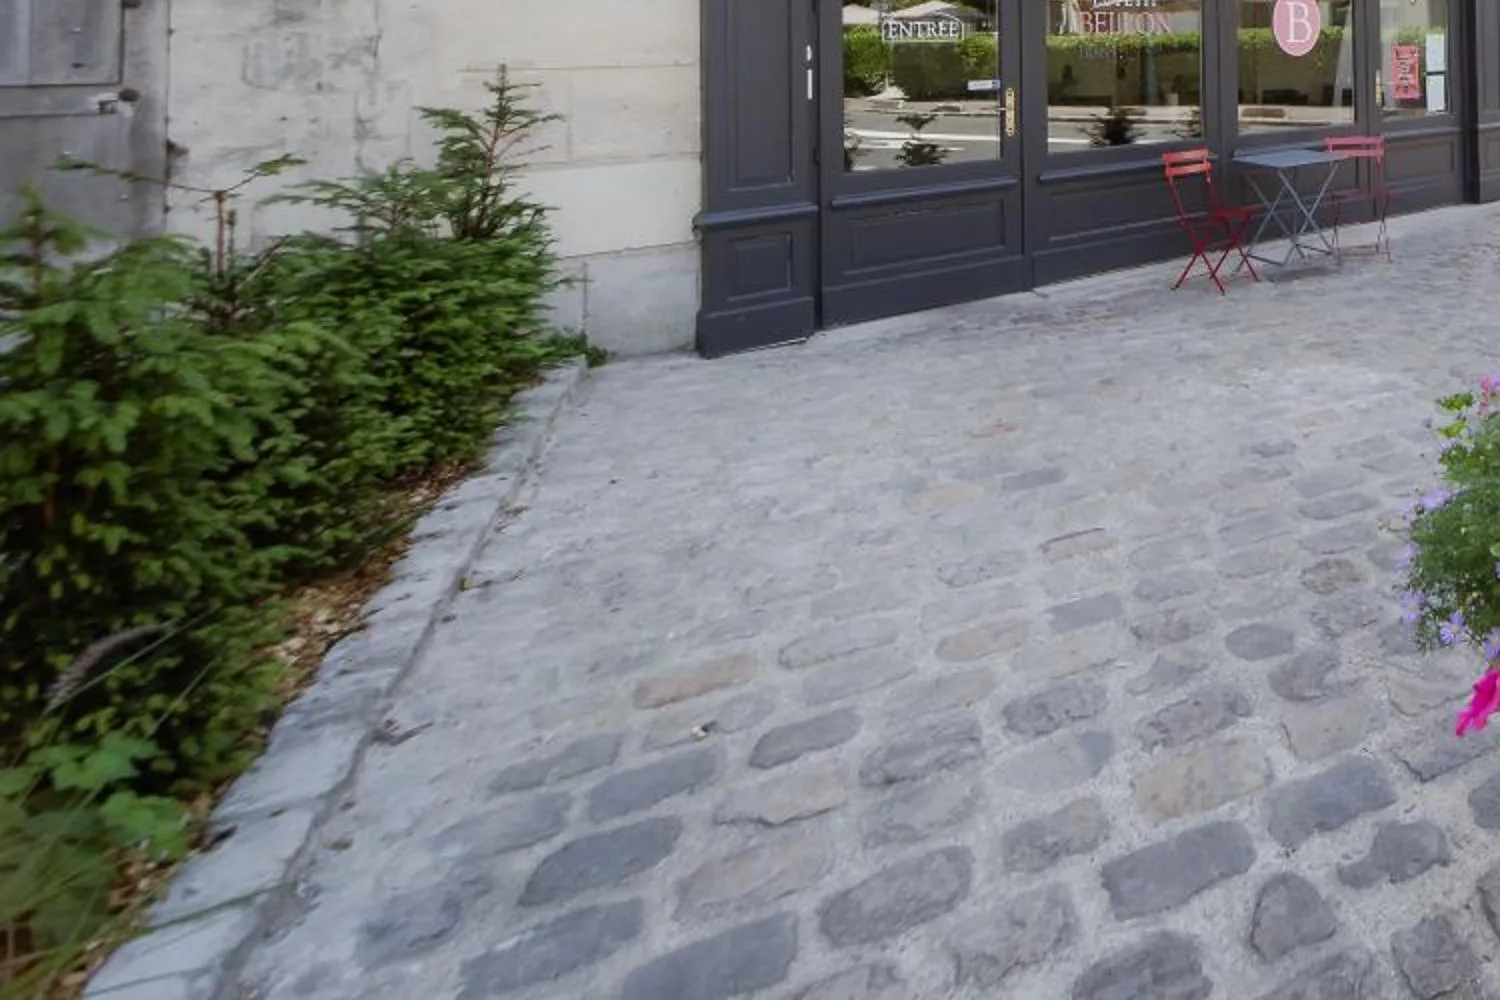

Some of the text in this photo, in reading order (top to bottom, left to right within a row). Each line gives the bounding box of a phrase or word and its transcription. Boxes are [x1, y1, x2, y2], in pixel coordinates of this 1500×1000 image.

[886, 19, 959, 40] ENTRÉE
[1078, 11, 1173, 35] BELLON
[1284, 0, 1313, 43] B
